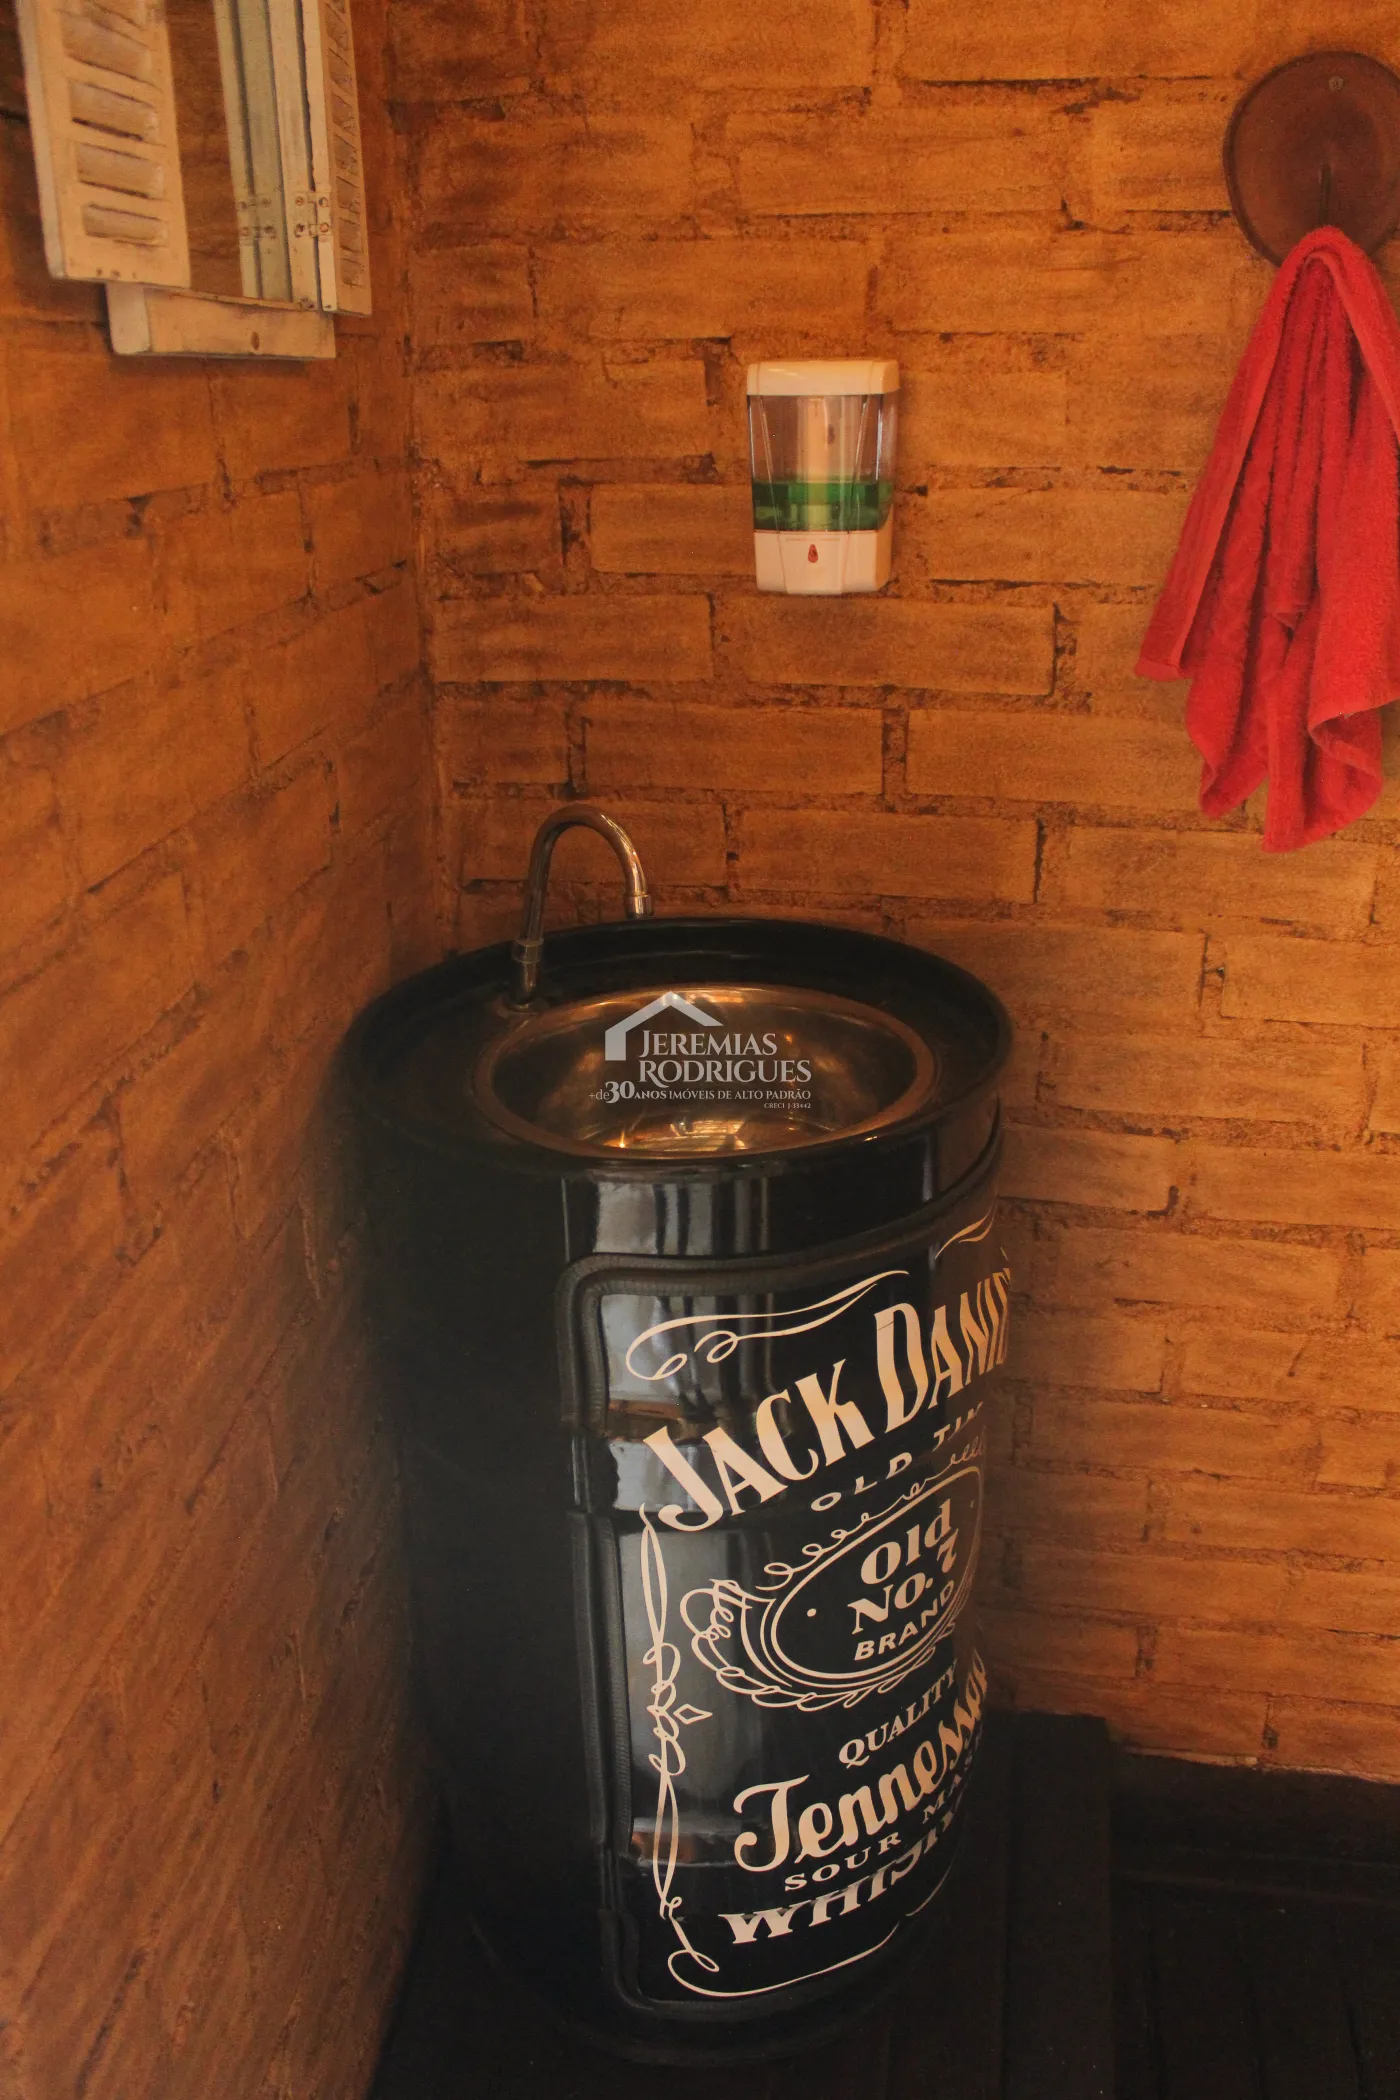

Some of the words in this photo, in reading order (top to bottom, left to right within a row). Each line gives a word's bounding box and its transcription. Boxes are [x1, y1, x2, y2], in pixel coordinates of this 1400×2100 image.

[643, 1359, 875, 1532] JACK
[810, 1451, 913, 1512] OLD
[860, 1498, 952, 1585] Old
[854, 1579, 955, 1661] BRAND
[838, 1658, 958, 1769] QUALITY
[784, 1831, 902, 1892] SOUR
